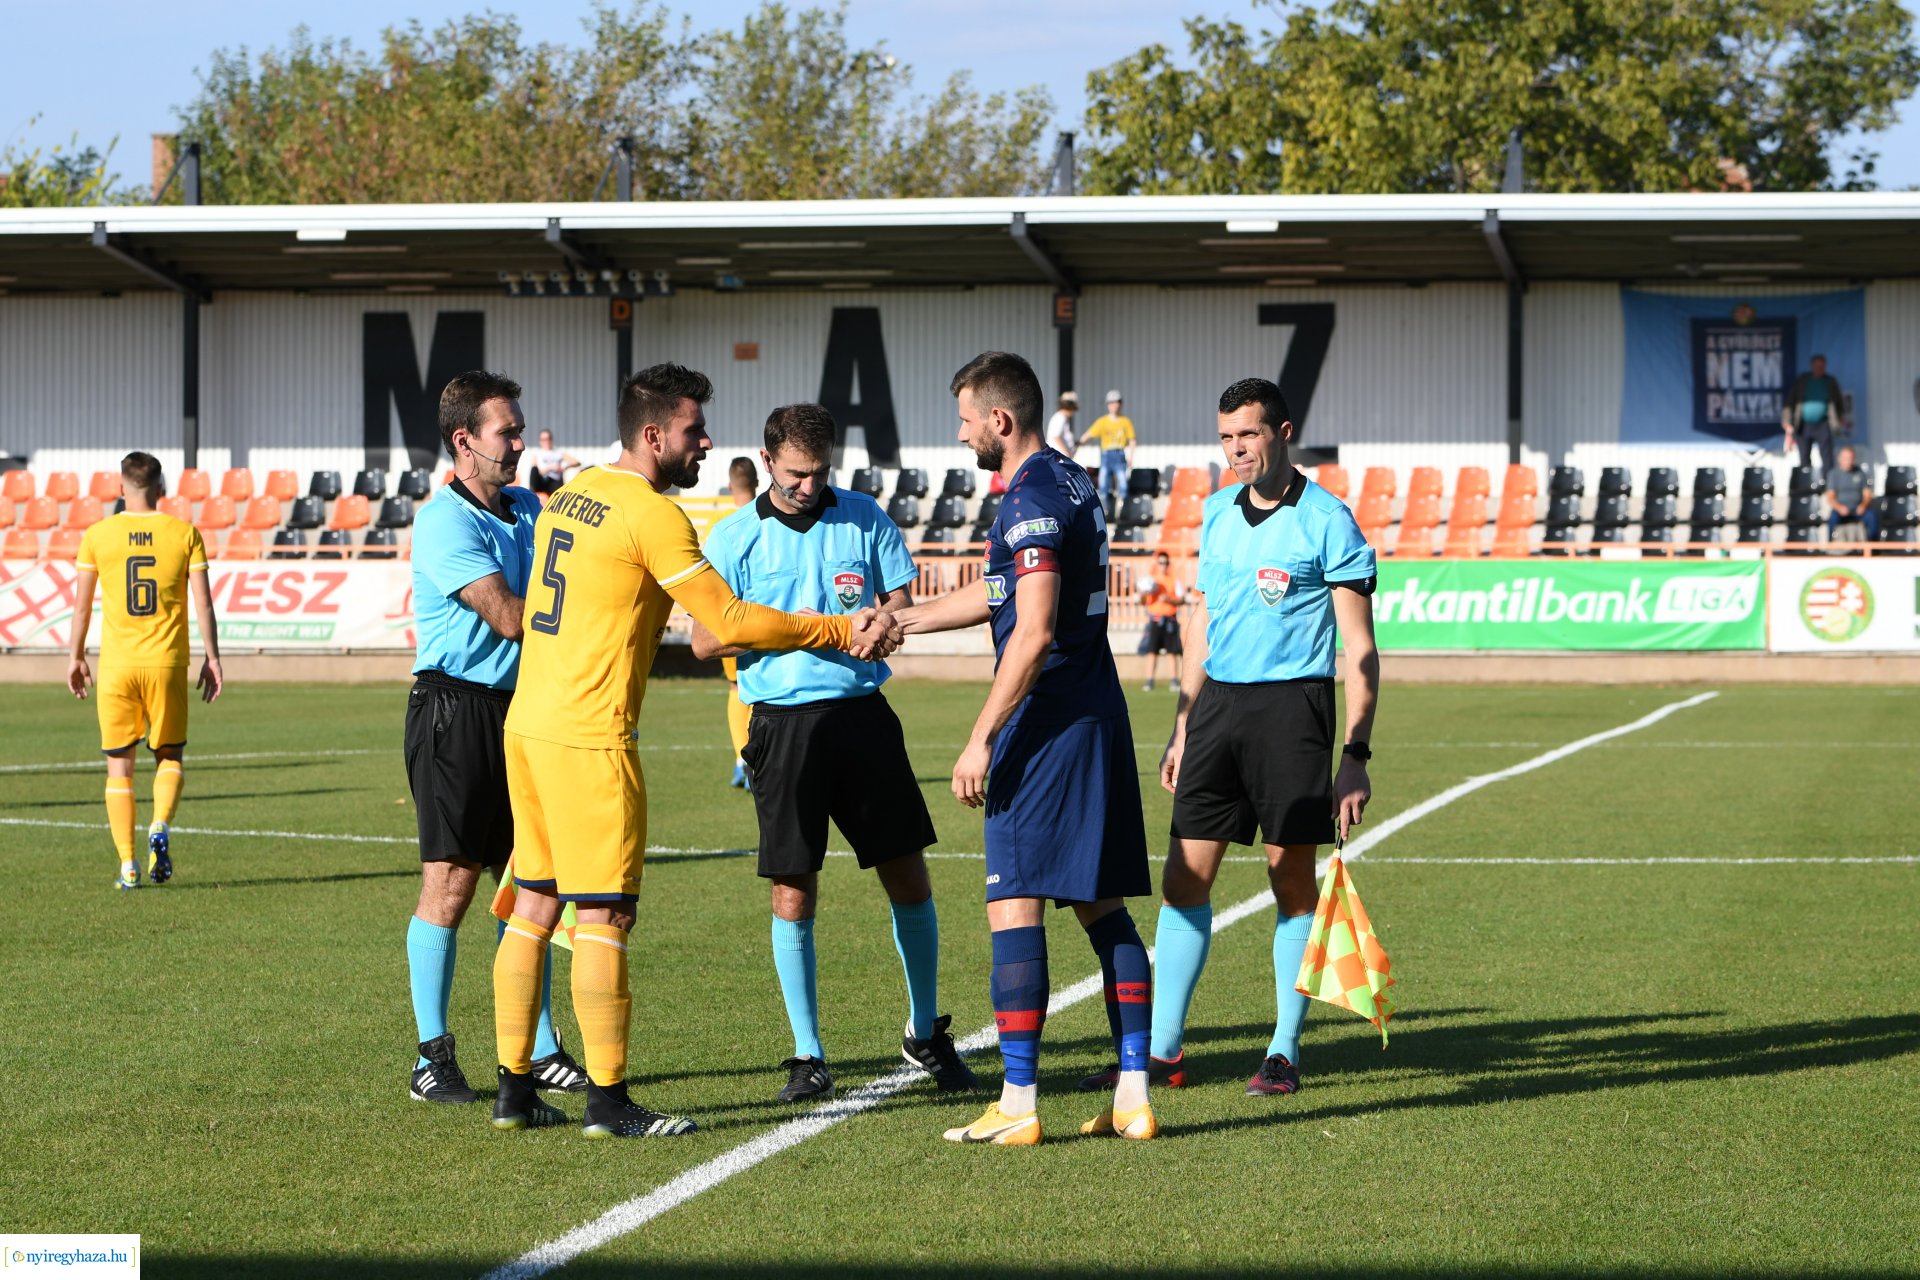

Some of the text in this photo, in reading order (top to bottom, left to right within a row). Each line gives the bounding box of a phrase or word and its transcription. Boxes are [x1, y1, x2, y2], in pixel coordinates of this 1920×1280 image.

[613, 300, 630, 320] D
[1056, 297, 1073, 318] E
[1706, 351, 1783, 389] NEM
[128, 531, 153, 546] MIM
[1023, 548, 1040, 568] C
[126, 555, 157, 617] 6
[531, 527, 574, 636] 5
[1667, 586, 1747, 613] LIGA
